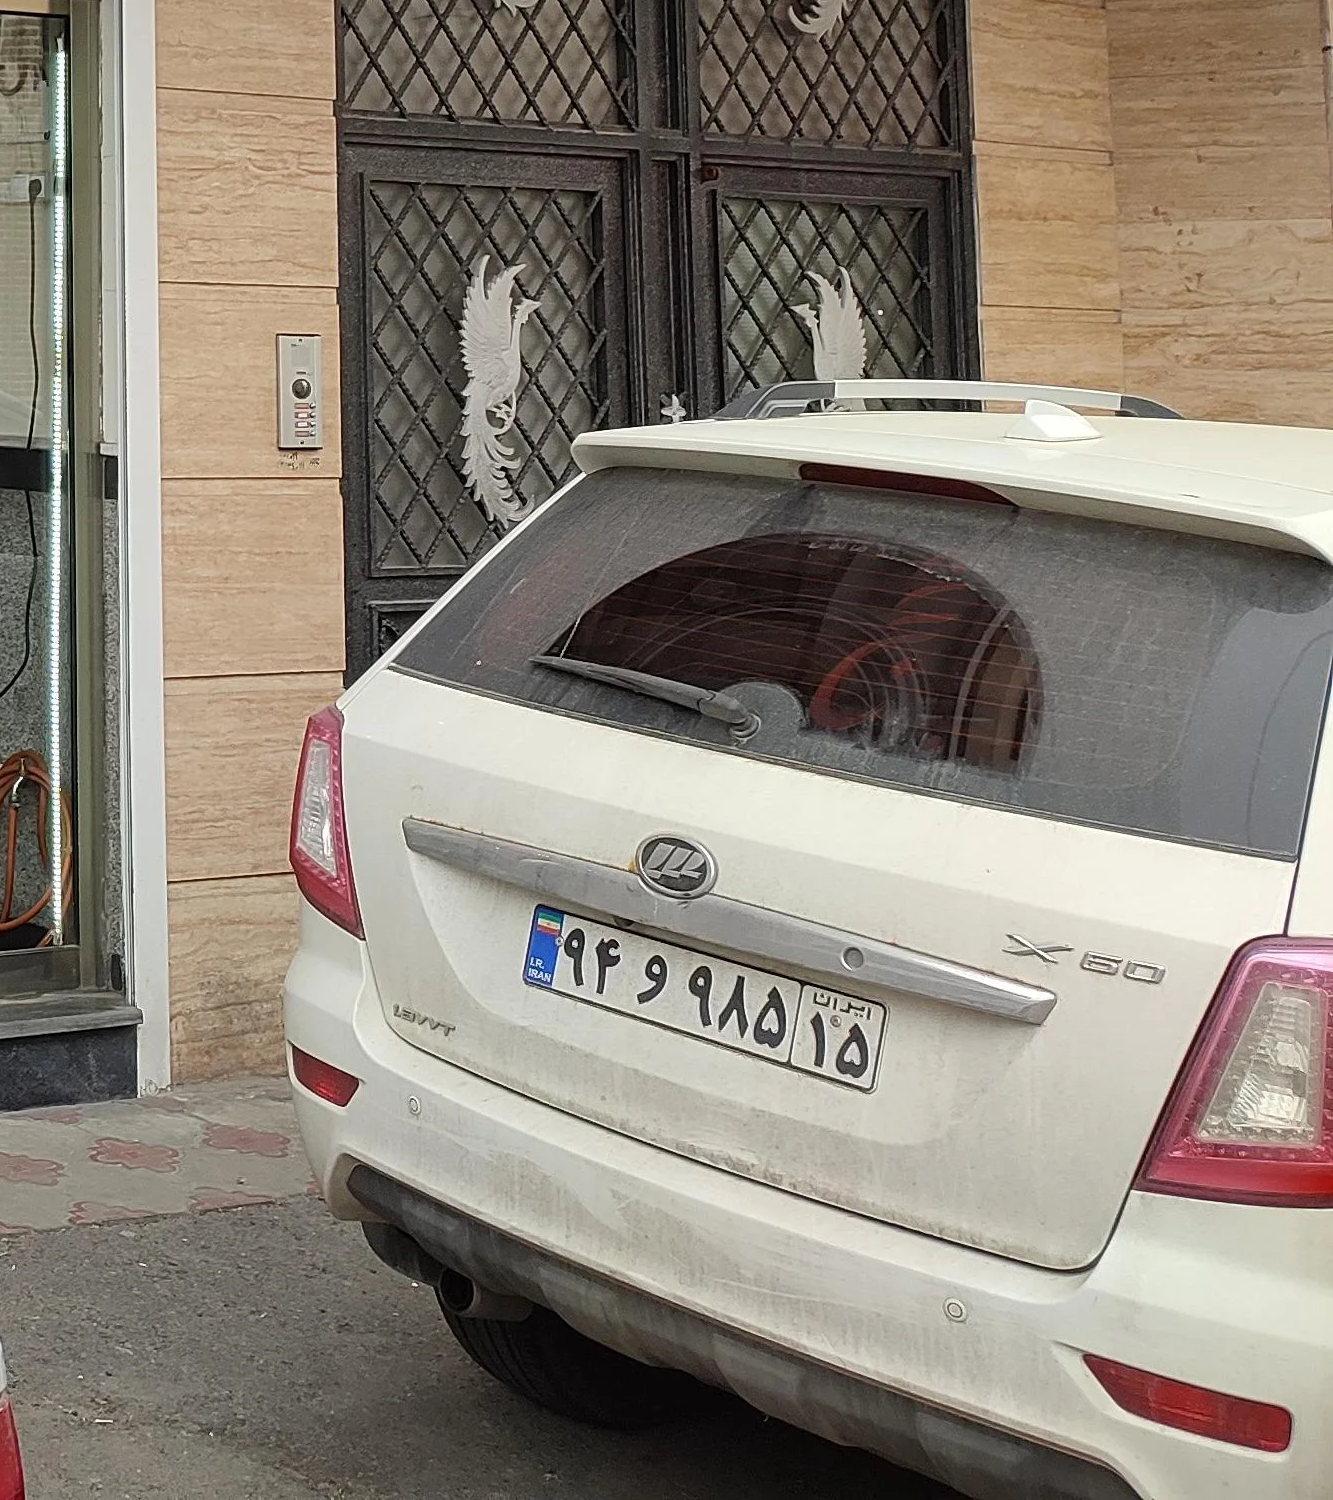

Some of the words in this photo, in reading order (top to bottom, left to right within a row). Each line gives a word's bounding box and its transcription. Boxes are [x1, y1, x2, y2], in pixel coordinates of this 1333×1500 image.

[528, 967, 552, 983] IRAN
[564, 928, 621, 995] ۹۴
[688, 965, 786, 1049] ۹۸۵
[813, 991, 872, 1020] ایران
[810, 1010, 869, 1079] ۱۵
